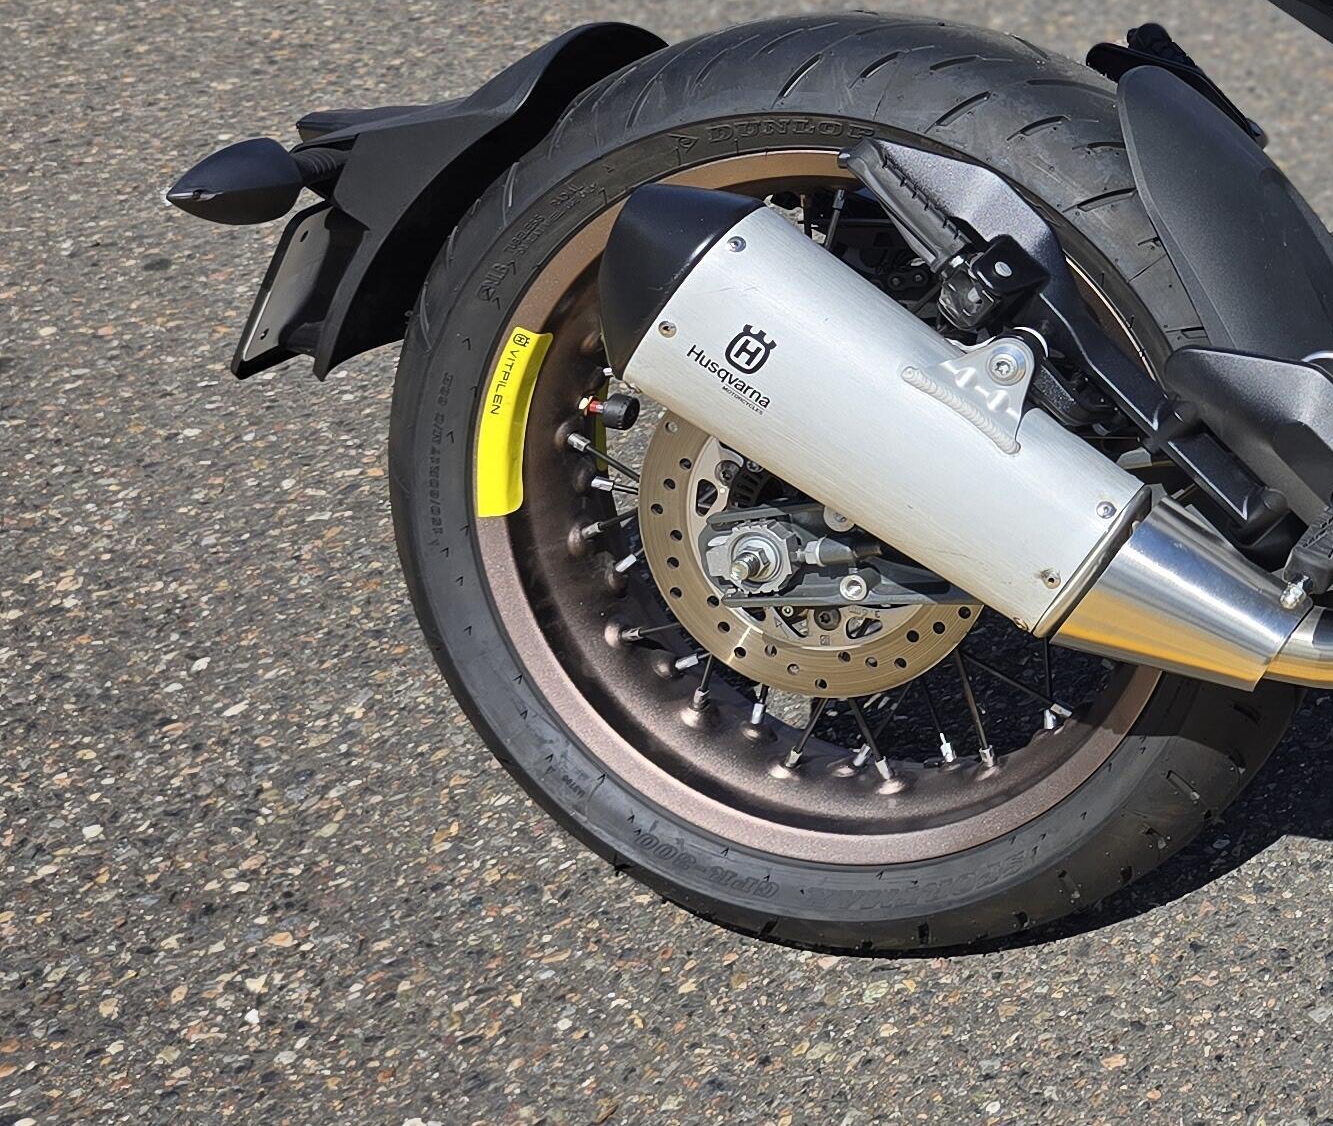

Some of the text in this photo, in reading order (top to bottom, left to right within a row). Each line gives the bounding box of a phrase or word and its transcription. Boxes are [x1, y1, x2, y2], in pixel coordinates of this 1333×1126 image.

[705, 118, 876, 142] DUNLOP
[490, 349, 520, 415] VITPILEN
[687, 344, 771, 409] Husqvarna
[722, 385, 764, 415] MOTORCYCLES
